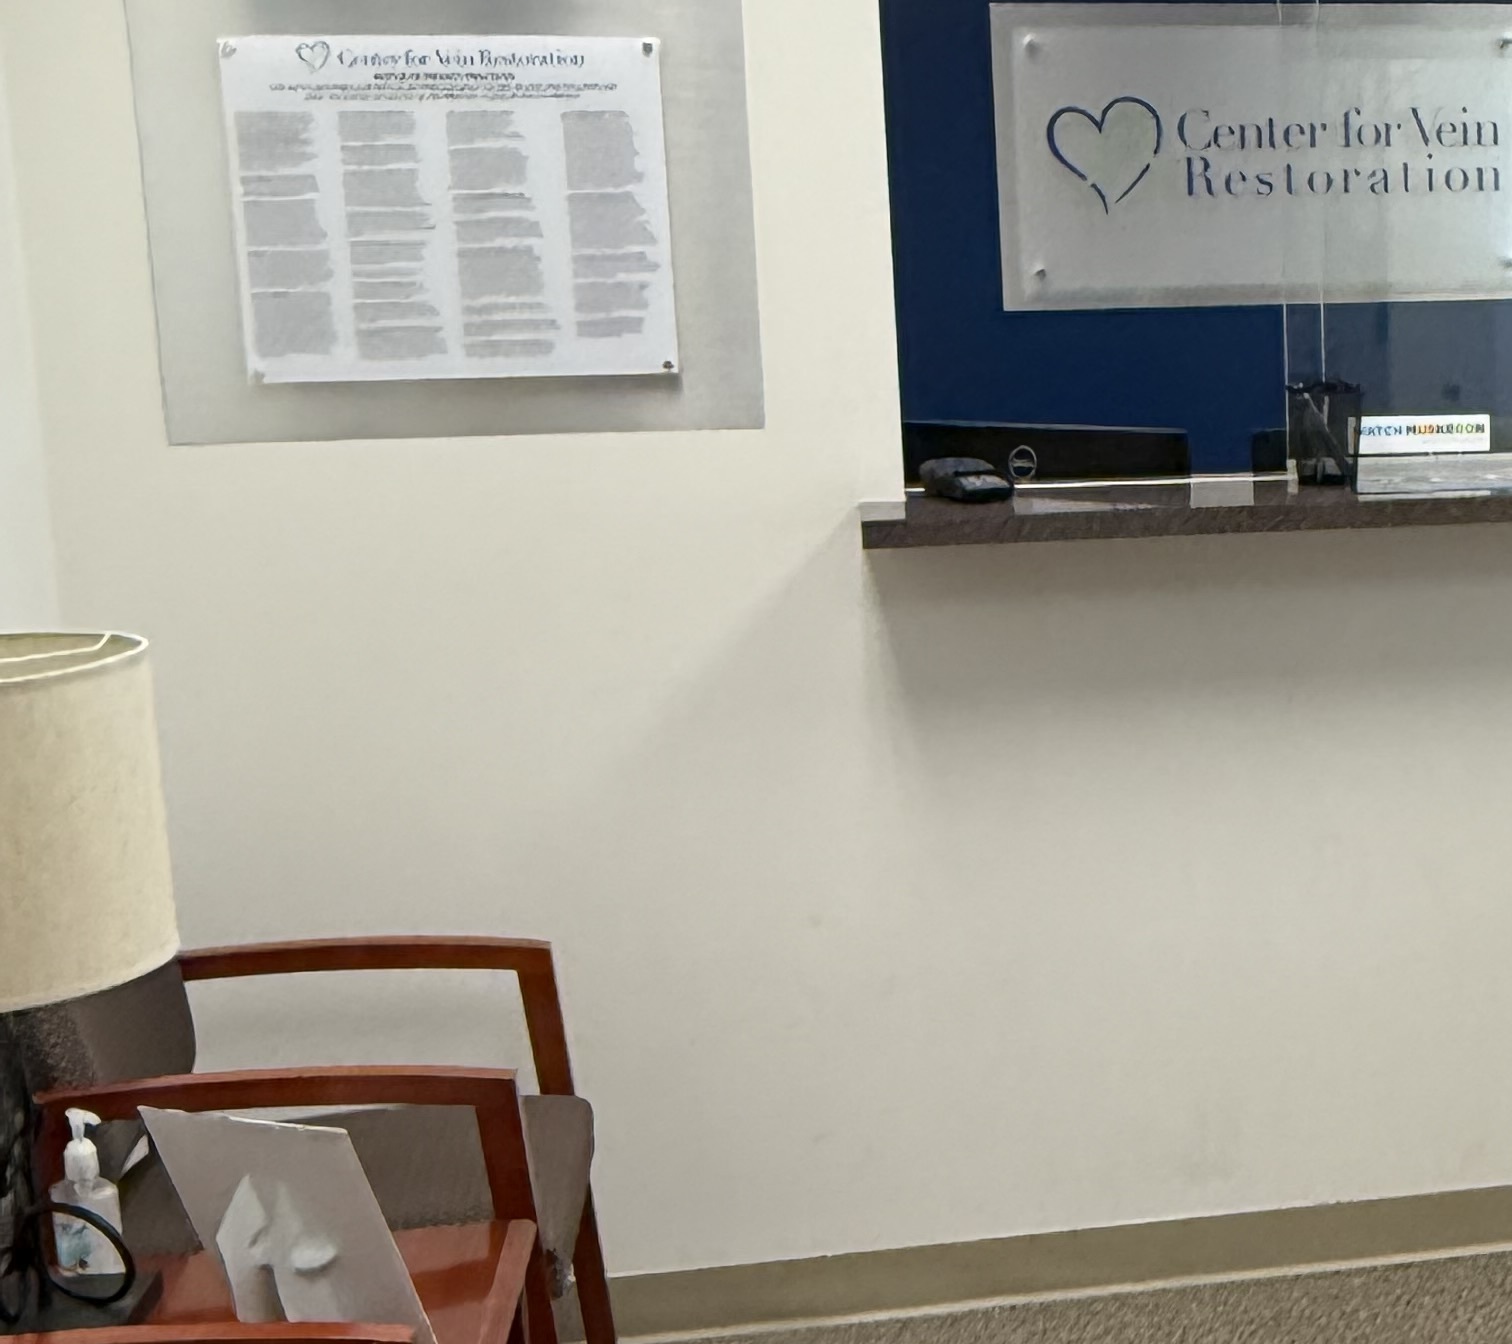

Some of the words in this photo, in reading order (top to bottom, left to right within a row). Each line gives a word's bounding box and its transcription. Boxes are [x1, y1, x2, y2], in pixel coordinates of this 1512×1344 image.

[336, 47, 401, 68] Center
[404, 47, 430, 67] for
[435, 48, 474, 68] Vein
[1176, 106, 1327, 151] Center
[1338, 106, 1402, 148] for
[1409, 106, 1499, 148] Vein
[1186, 153, 1501, 197] Restoration
